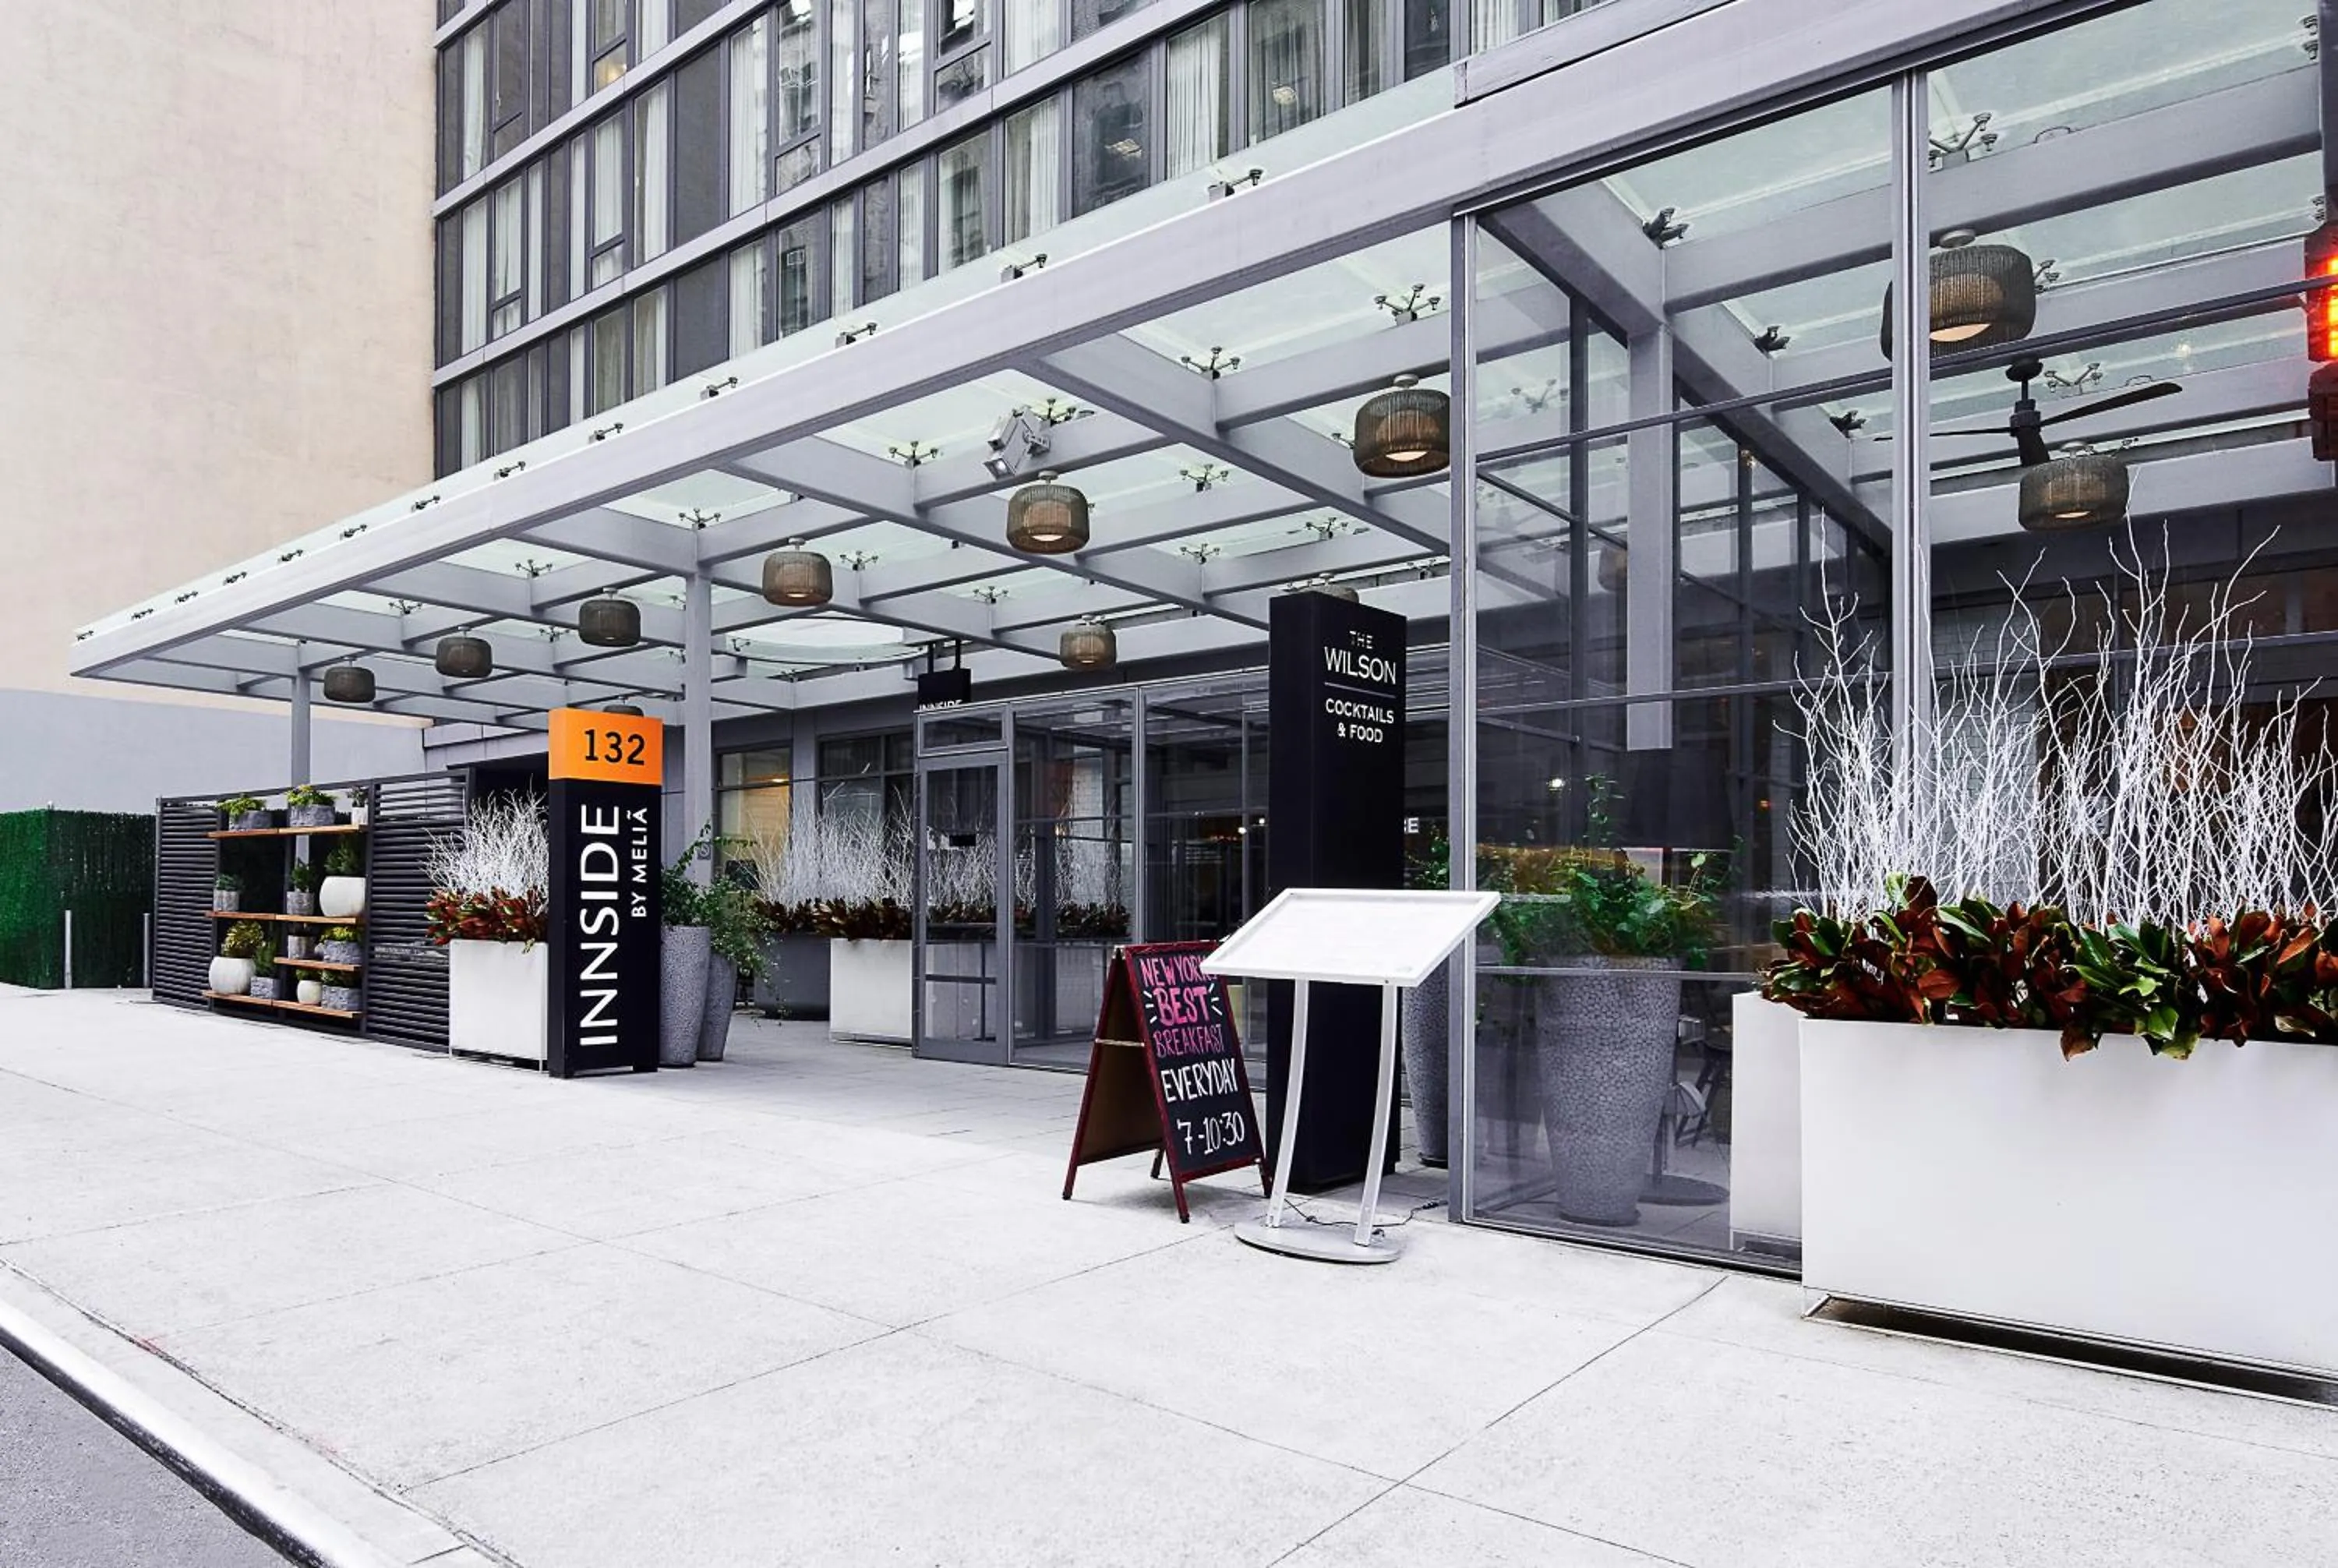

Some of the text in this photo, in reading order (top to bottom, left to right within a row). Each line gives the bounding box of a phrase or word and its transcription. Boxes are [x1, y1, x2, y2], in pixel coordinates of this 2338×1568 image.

[1349, 630, 1373, 649] THE
[1324, 646, 1397, 685] WILSON
[1325, 697, 1394, 724] COCKTAILS
[584, 729, 645, 765] 132
[1337, 722, 1383, 743] & FOOD
[631, 892, 647, 917] BY
[579, 804, 620, 1046] INNSIDE
[1139, 955, 1218, 987] NEW YOR
[1153, 986, 1210, 1026] BEST
[1153, 1023, 1225, 1058] BREAKFAST
[1160, 1058, 1238, 1103] EVERYDAY
